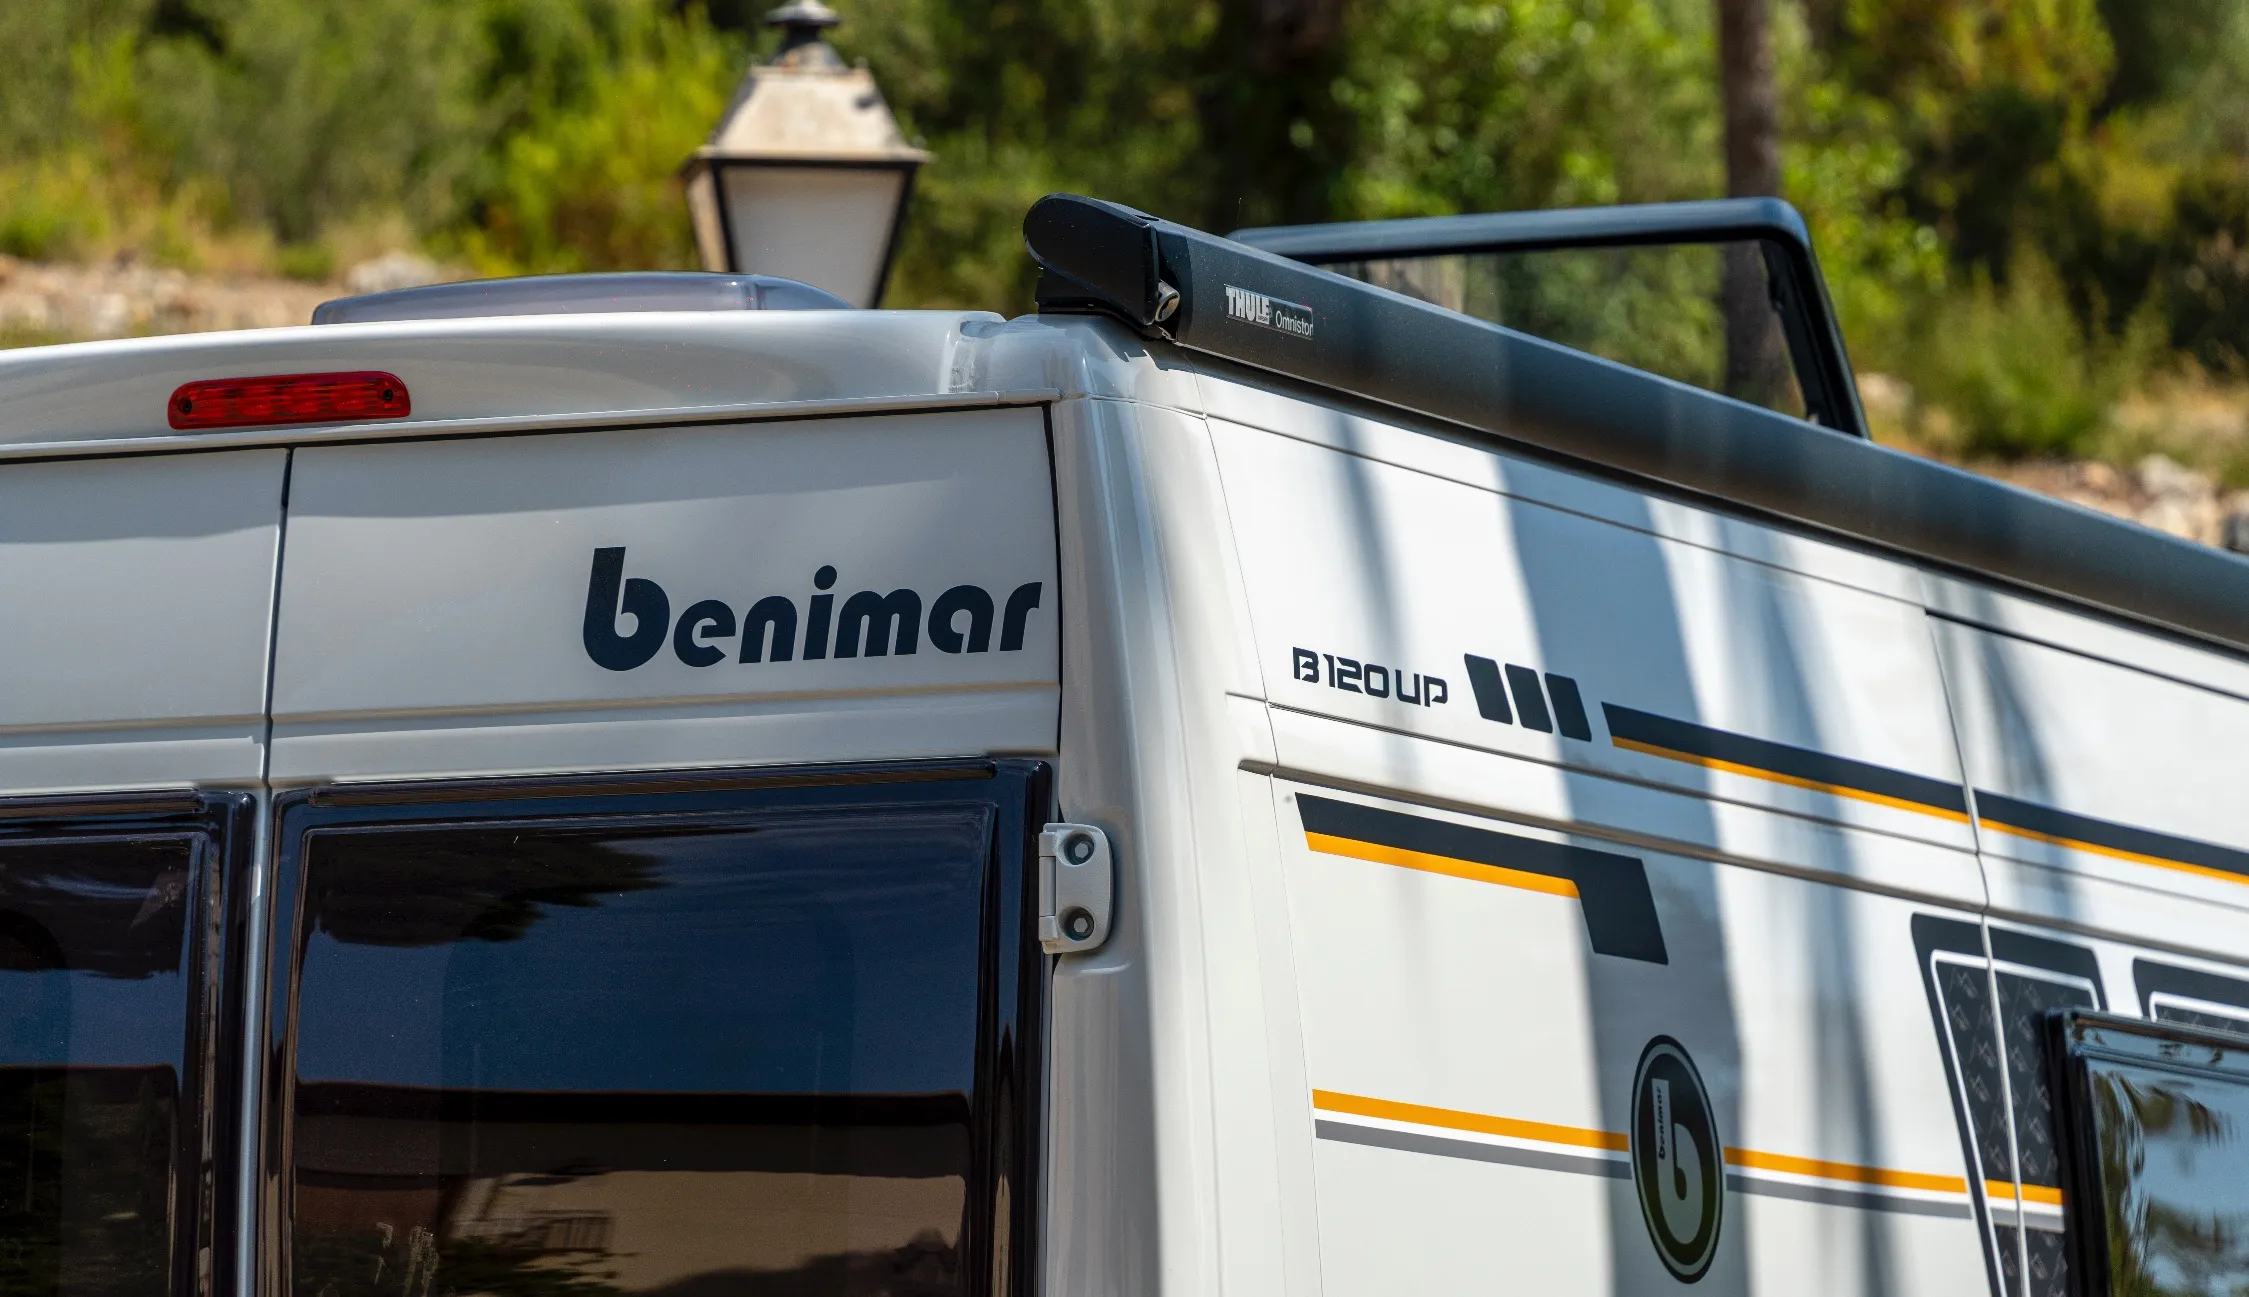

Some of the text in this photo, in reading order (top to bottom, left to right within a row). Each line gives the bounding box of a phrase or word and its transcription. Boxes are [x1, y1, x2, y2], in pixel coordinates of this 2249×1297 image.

[1225, 286, 1314, 336] THULE Omnistor
[583, 546, 1043, 672] benimar
